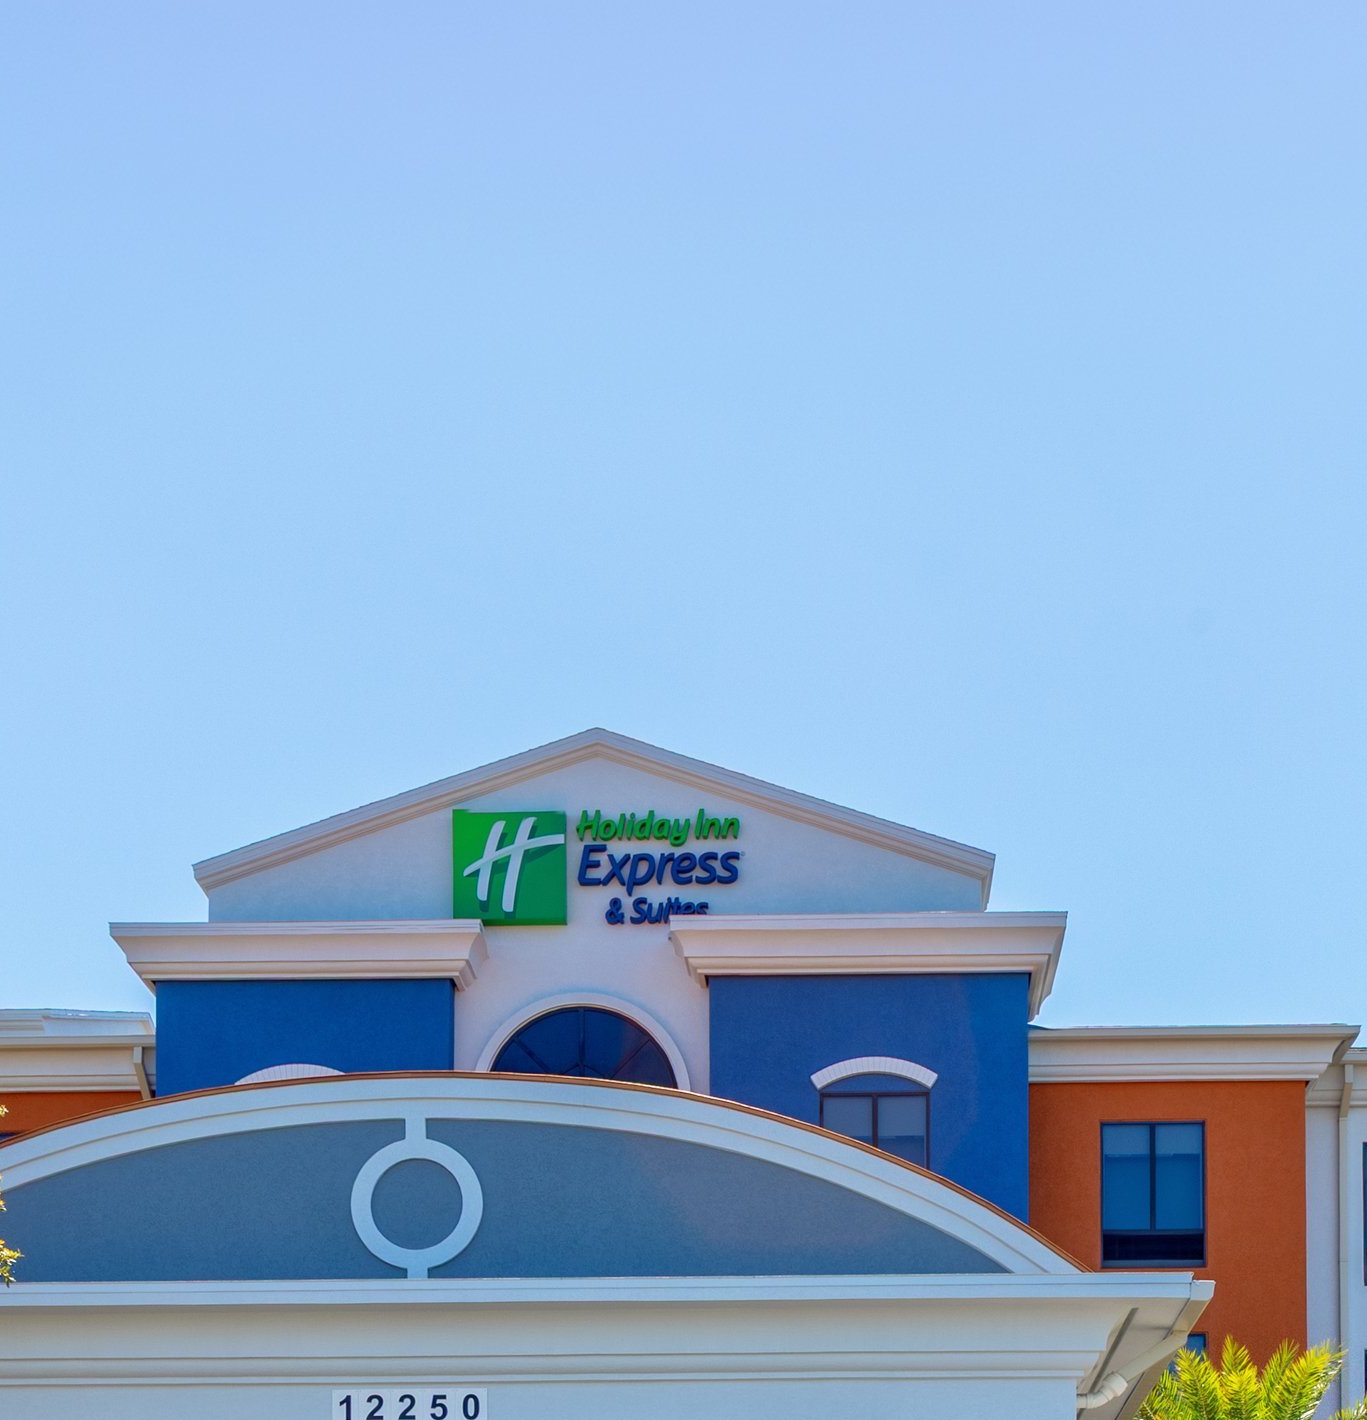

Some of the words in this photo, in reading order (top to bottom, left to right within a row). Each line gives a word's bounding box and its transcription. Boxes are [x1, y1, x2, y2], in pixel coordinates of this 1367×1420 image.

[576, 809, 691, 847] Holiday
[694, 808, 740, 840] Inn
[578, 844, 741, 897] Express
[605, 897, 625, 925] &
[339, 1393, 480, 1420] 12250
